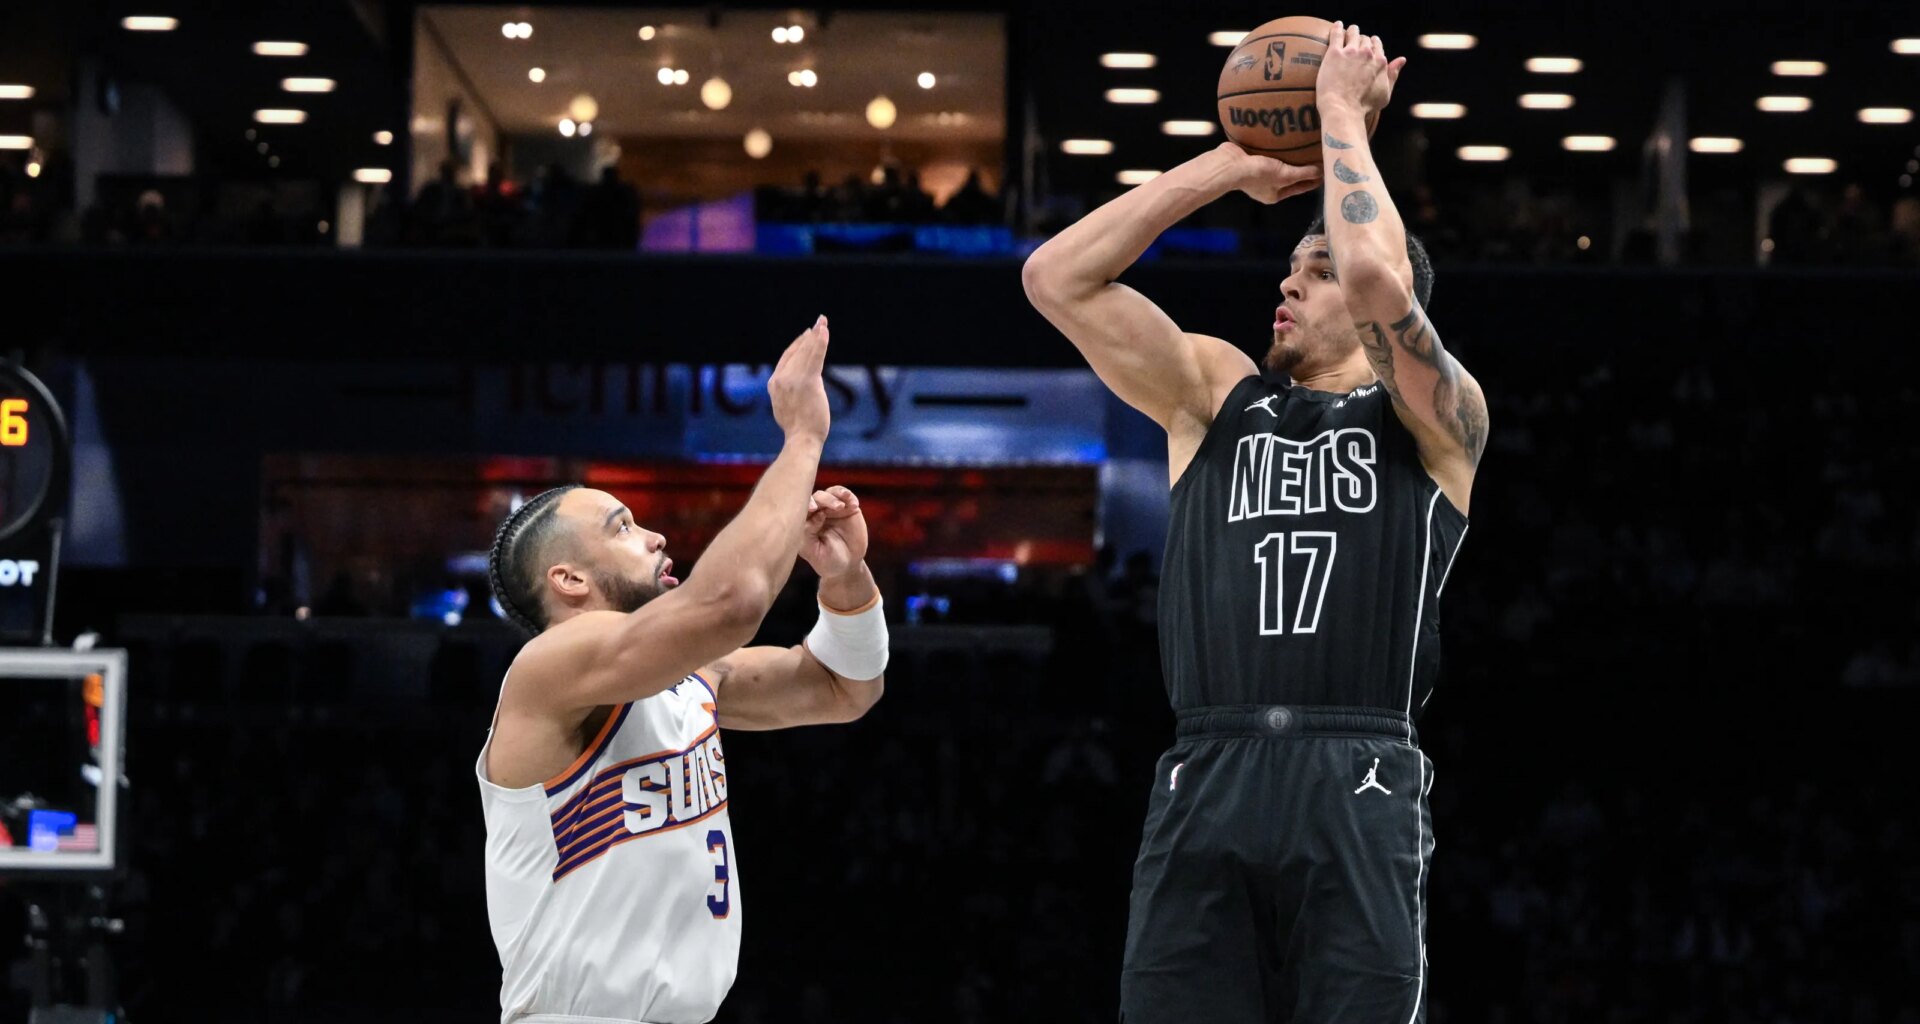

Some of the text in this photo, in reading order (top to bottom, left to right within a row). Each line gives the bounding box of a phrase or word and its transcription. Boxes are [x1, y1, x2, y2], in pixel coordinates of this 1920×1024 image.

[0, 399, 28, 446] 6
[1228, 427, 1377, 523] NETS
[1254, 531, 1337, 636] 17
[621, 733, 728, 834] SUNS
[706, 829, 730, 919] 3
